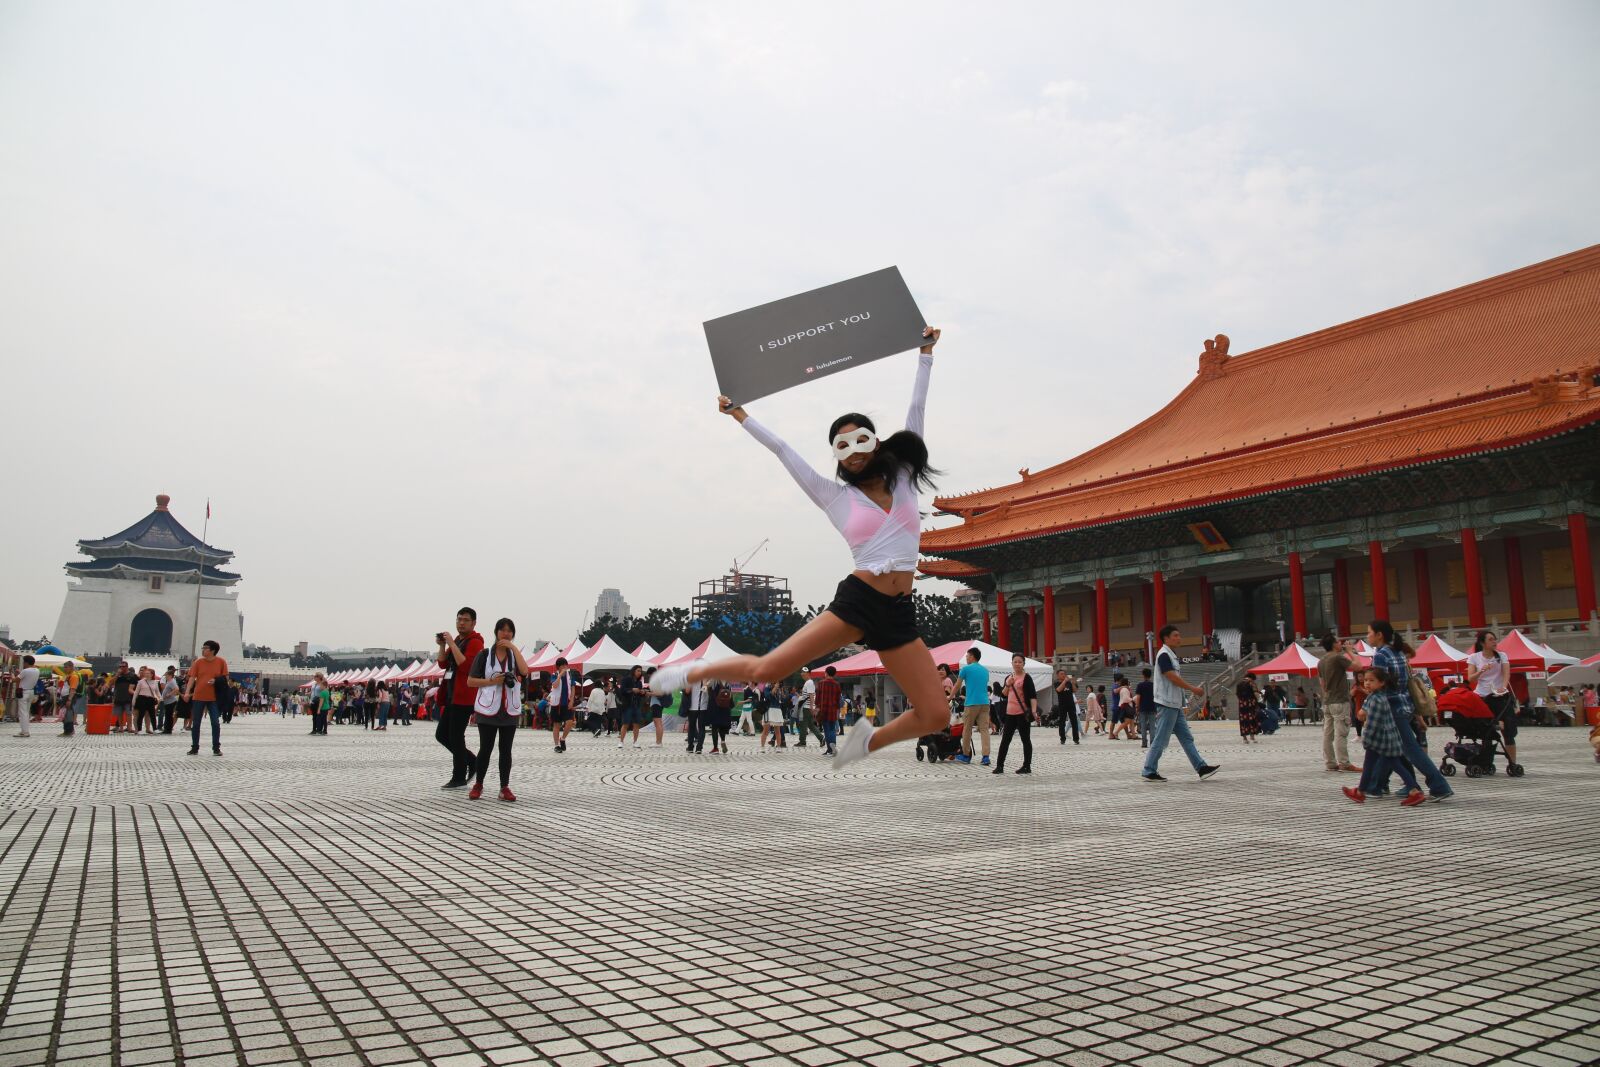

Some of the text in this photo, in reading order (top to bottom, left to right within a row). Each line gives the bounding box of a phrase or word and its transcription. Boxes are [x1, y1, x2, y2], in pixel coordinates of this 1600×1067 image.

[759, 311, 871, 352] I SUPPORT YOU
[816, 355, 852, 370] lululemon
